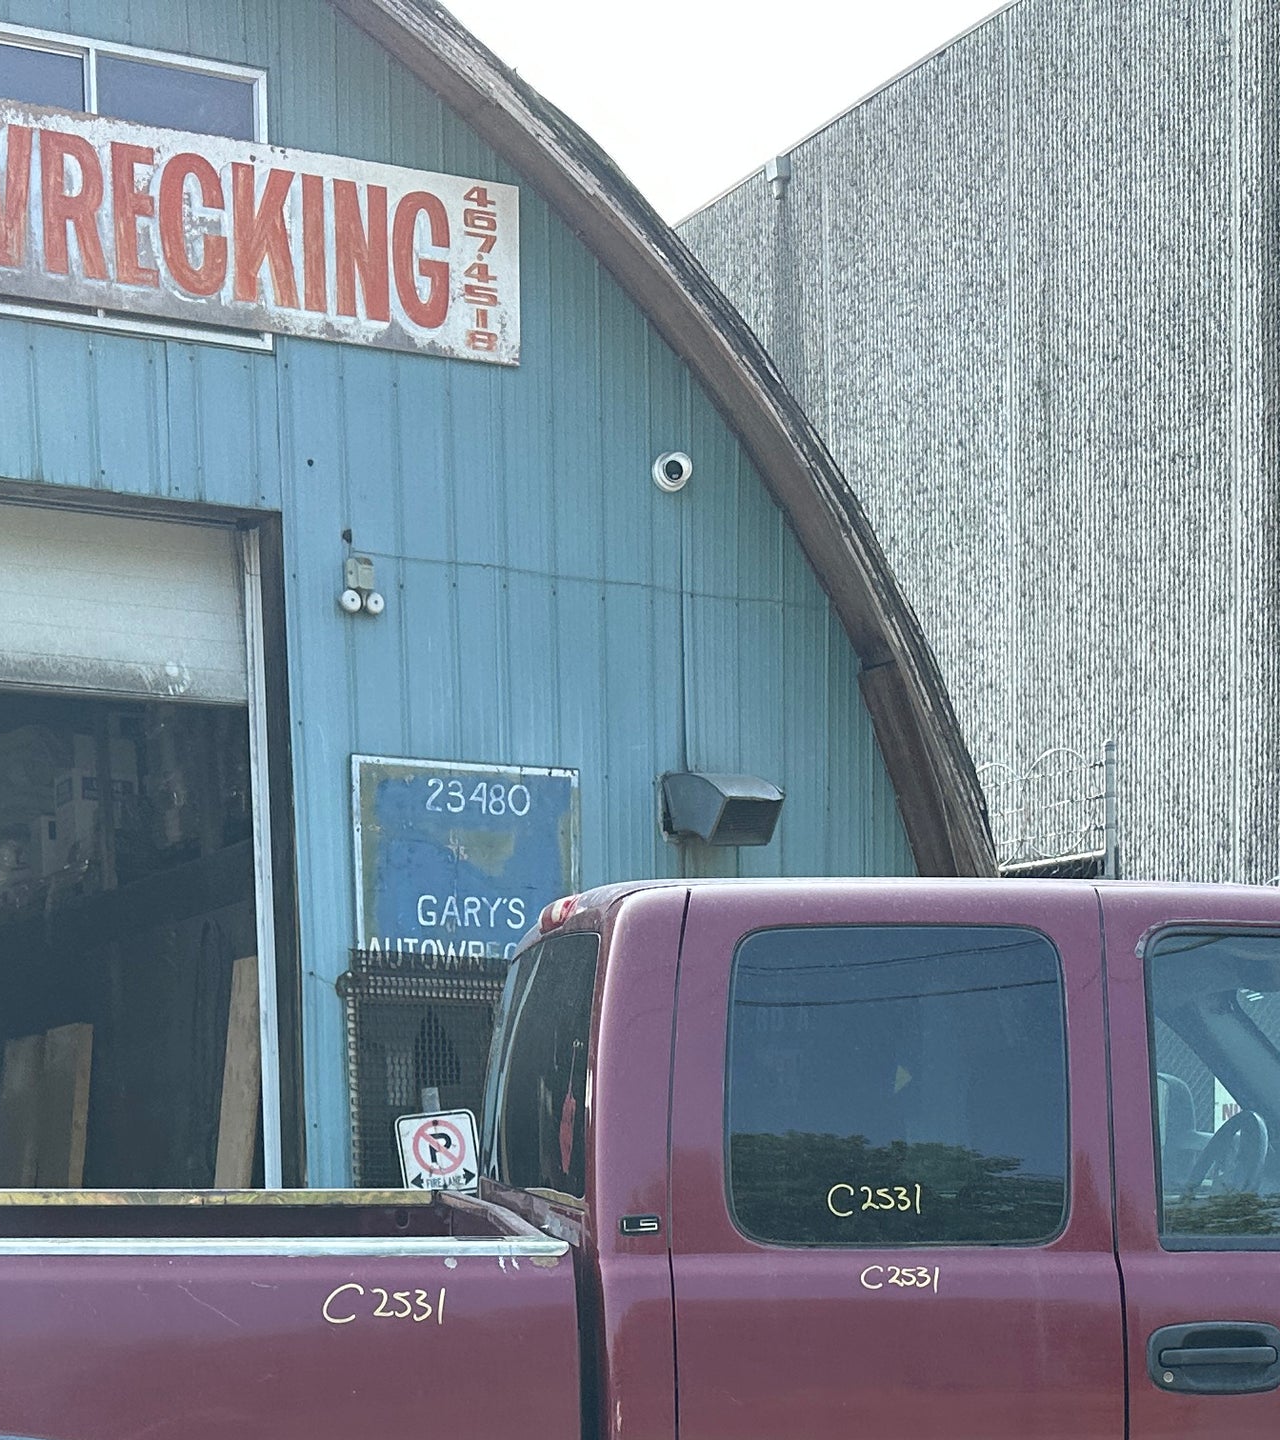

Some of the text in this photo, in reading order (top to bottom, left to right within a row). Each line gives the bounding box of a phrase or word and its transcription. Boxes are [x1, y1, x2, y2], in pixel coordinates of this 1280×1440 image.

[425, 778, 532, 817] 23480
[417, 895, 526, 930] GARY'S
[827, 1183, 921, 1217] C2531
[622, 1218, 658, 1233] LS
[860, 1265, 939, 1293] C2531
[322, 1283, 446, 1325] C2531
